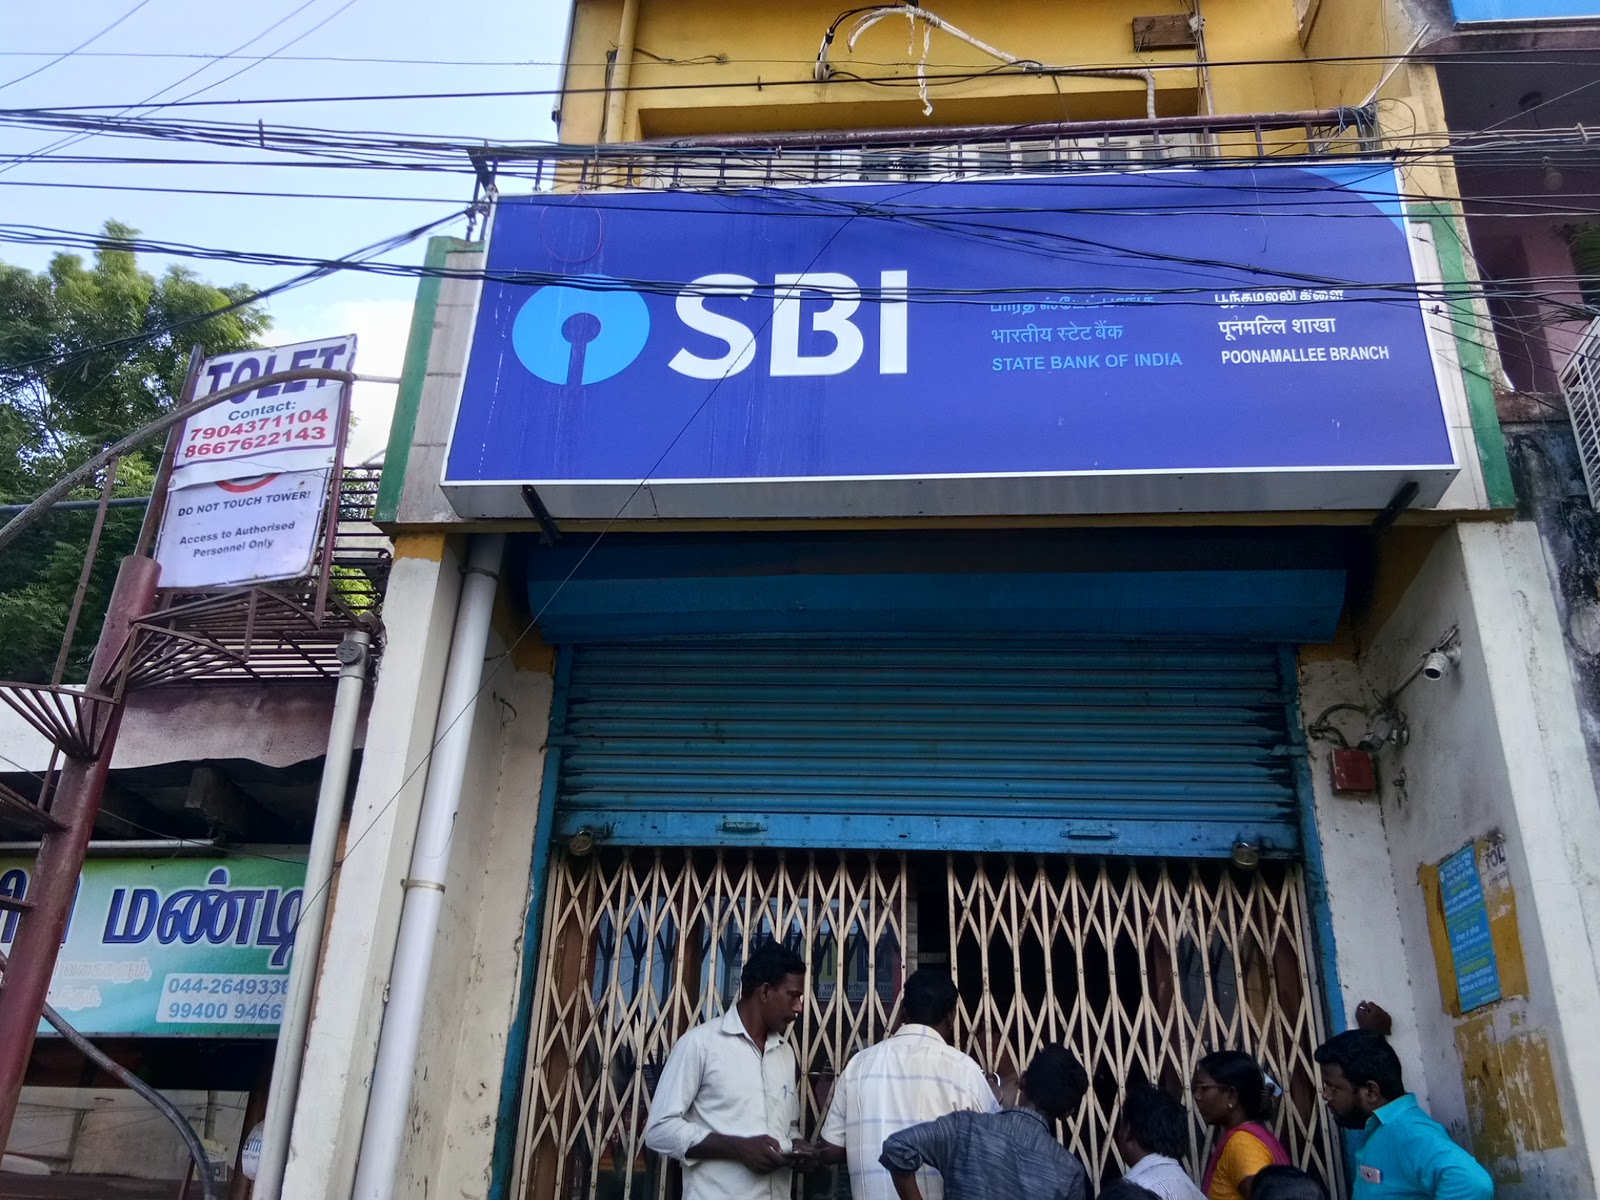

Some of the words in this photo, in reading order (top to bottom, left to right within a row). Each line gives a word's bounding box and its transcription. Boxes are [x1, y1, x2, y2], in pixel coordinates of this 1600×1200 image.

[667, 270, 908, 380] SBI
[991, 323, 1052, 344] भारतीय
[1056, 321, 1092, 341] स्टेट
[1093, 320, 1124, 340] बैंक
[1292, 318, 1337, 334] शाखा
[992, 357, 1045, 372] STATE
[1050, 355, 1101, 370] BANK
[1105, 354, 1128, 368] OF
[1134, 352, 1184, 367] INDIA
[1221, 348, 1328, 364] POONAMALLEE
[1330, 346, 1391, 362] BRANCH
[228, 400, 297, 422] Contact:
[190, 408, 329, 442] 7904371104
[184, 427, 326, 459] 8667622143
[178, 507, 194, 517] DO
[196, 502, 220, 514] NOT
[223, 496, 262, 510] TOUCH
[266, 491, 312, 503] TOWER!
[179, 533, 219, 546] Access
[221, 530, 233, 540] to
[235, 521, 296, 537] Authorised
[193, 541, 246, 558] Personnel
[248, 538, 275, 551] Only
[168, 1003, 228, 1019] 99400
[234, 1003, 282, 1020] 9466
